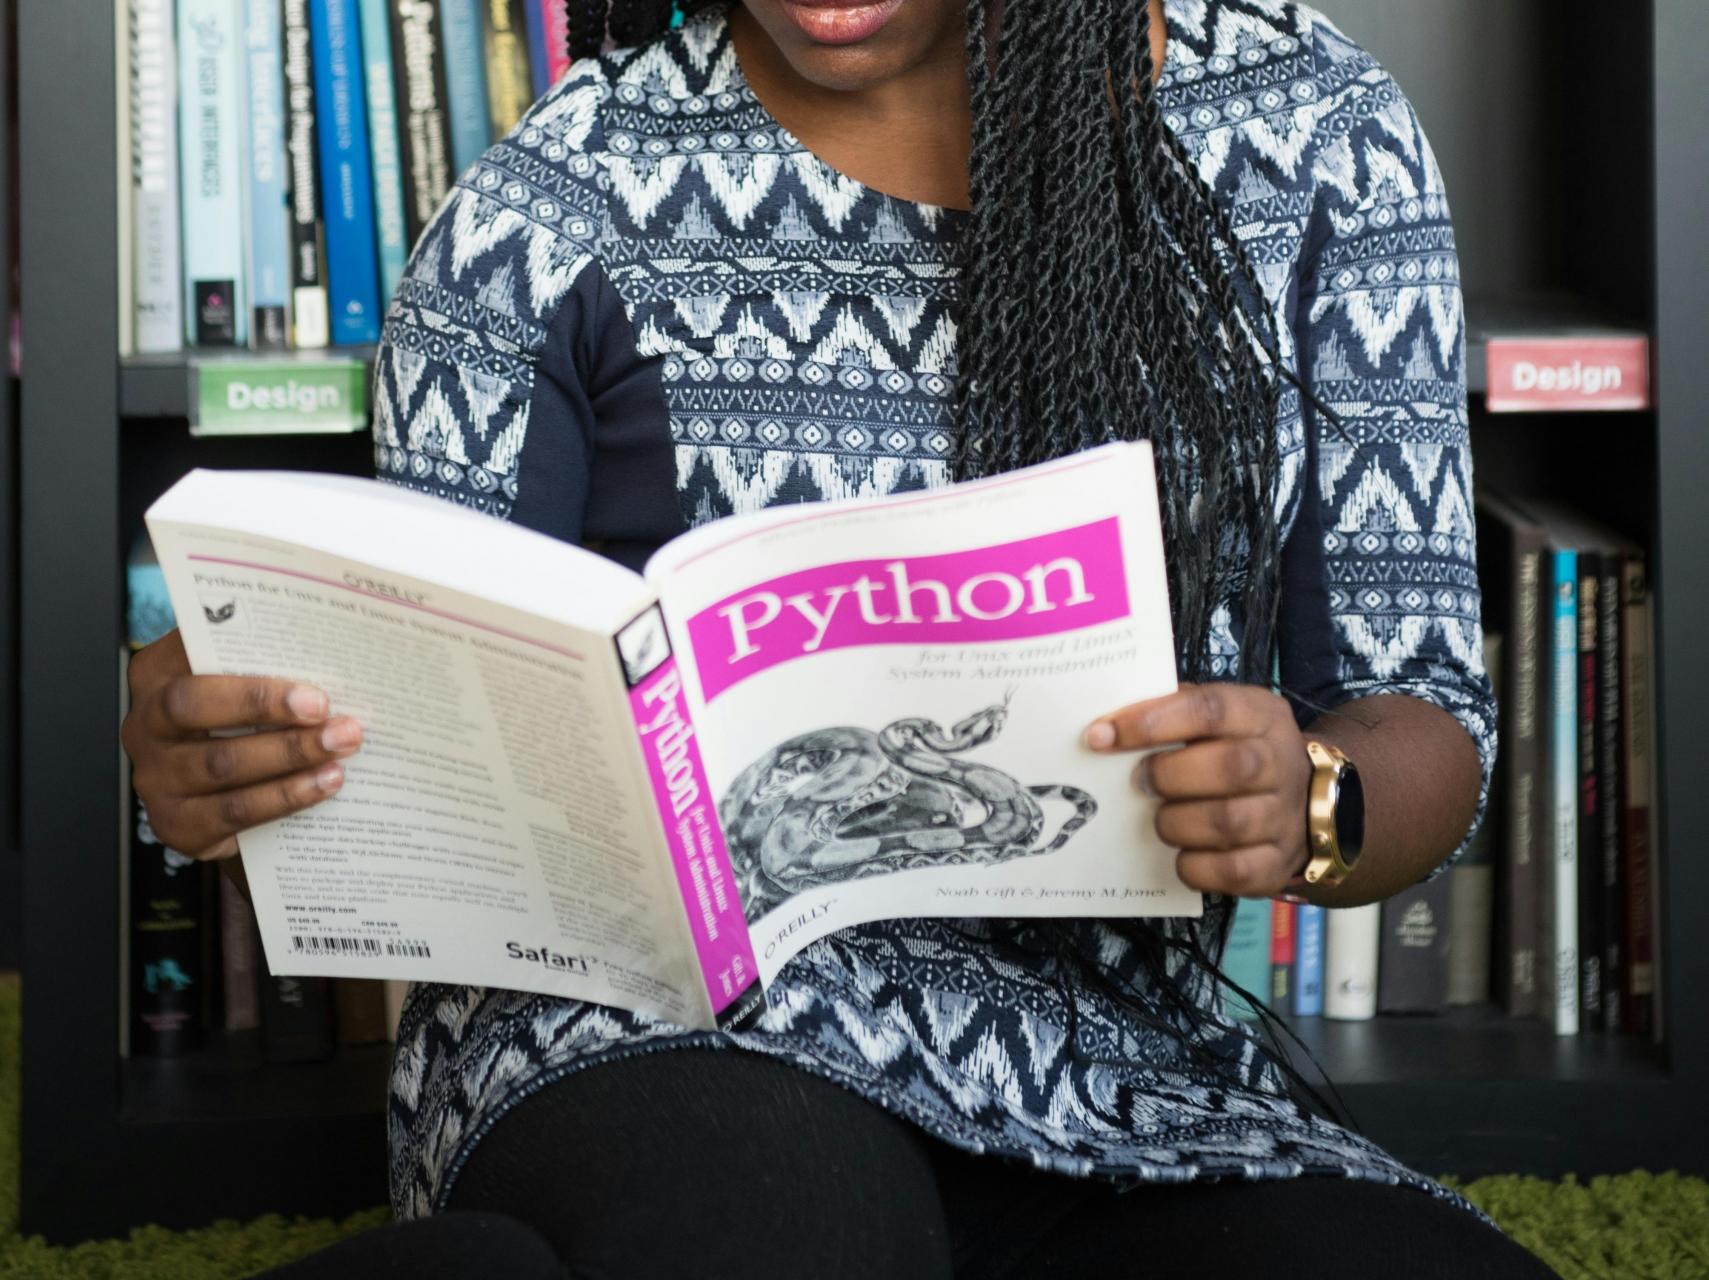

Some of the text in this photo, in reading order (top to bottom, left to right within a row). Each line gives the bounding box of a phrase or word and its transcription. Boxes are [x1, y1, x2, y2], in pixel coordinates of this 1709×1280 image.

[400, 1, 437, 110] Patterns
[250, 51, 277, 183] Interfaces
[1513, 360, 1622, 395] Design
[227, 379, 342, 419] Design
[718, 553, 1096, 666] Python
[886, 646, 1137, 683] System Administration
[1018, 638, 1065, 660] and
[638, 667, 700, 820] Python
[285, 905, 358, 915] www.oreilly.com
[690, 858, 719, 942] Administration
[935, 886, 980, 897] Noah
[985, 886, 1016, 901] Gift
[1038, 887, 1096, 901] Jeremy
[1121, 887, 1168, 900] Jones
[764, 900, 833, 960] O'REILLY
[506, 941, 589, 973] Safari
